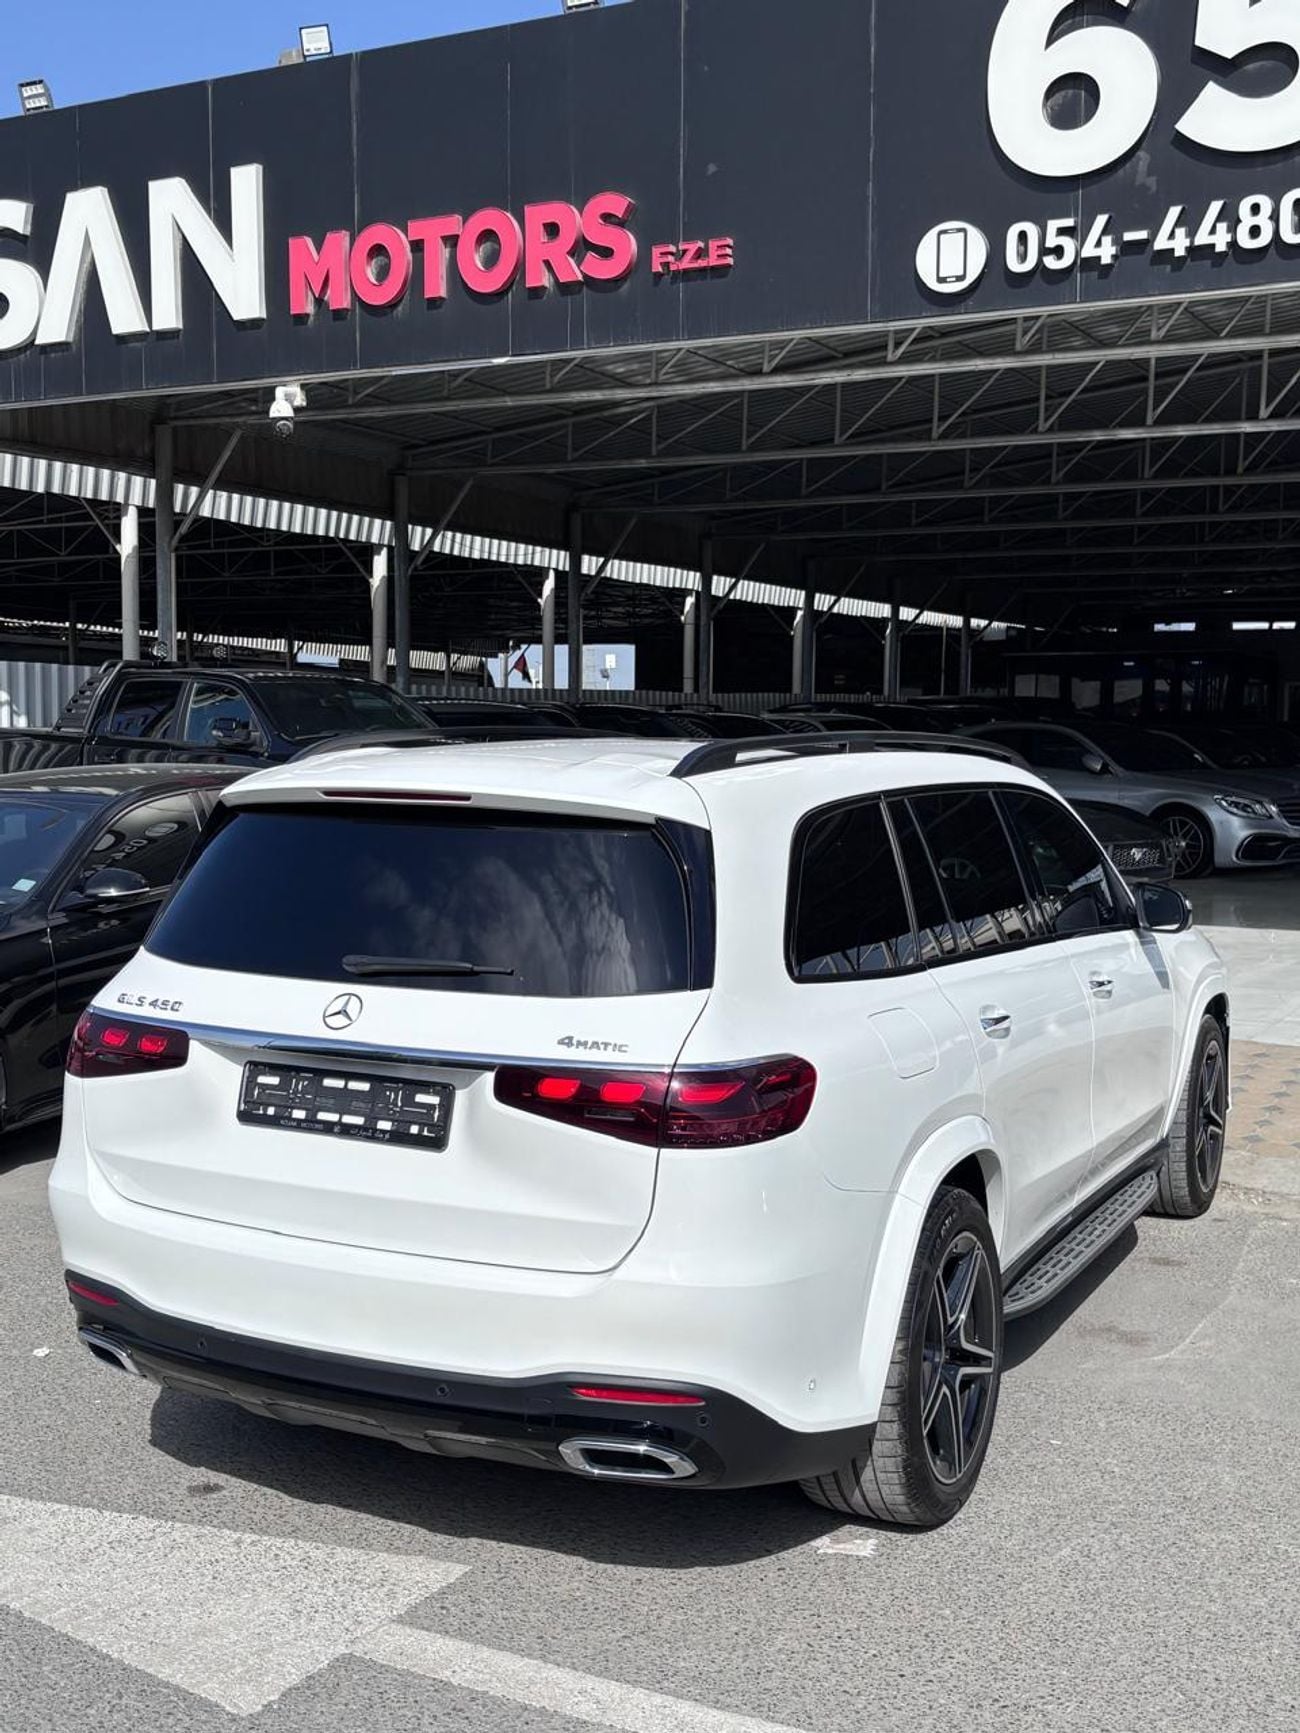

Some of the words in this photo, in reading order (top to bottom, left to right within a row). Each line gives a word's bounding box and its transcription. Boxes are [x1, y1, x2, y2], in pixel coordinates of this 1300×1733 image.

[987, 0, 1300, 177] 65
[289, 192, 637, 316] MOTORS
[117, 993, 146, 1007] GLS
[148, 998, 183, 1012] 450
[557, 1036, 629, 1053] 4MATIC
